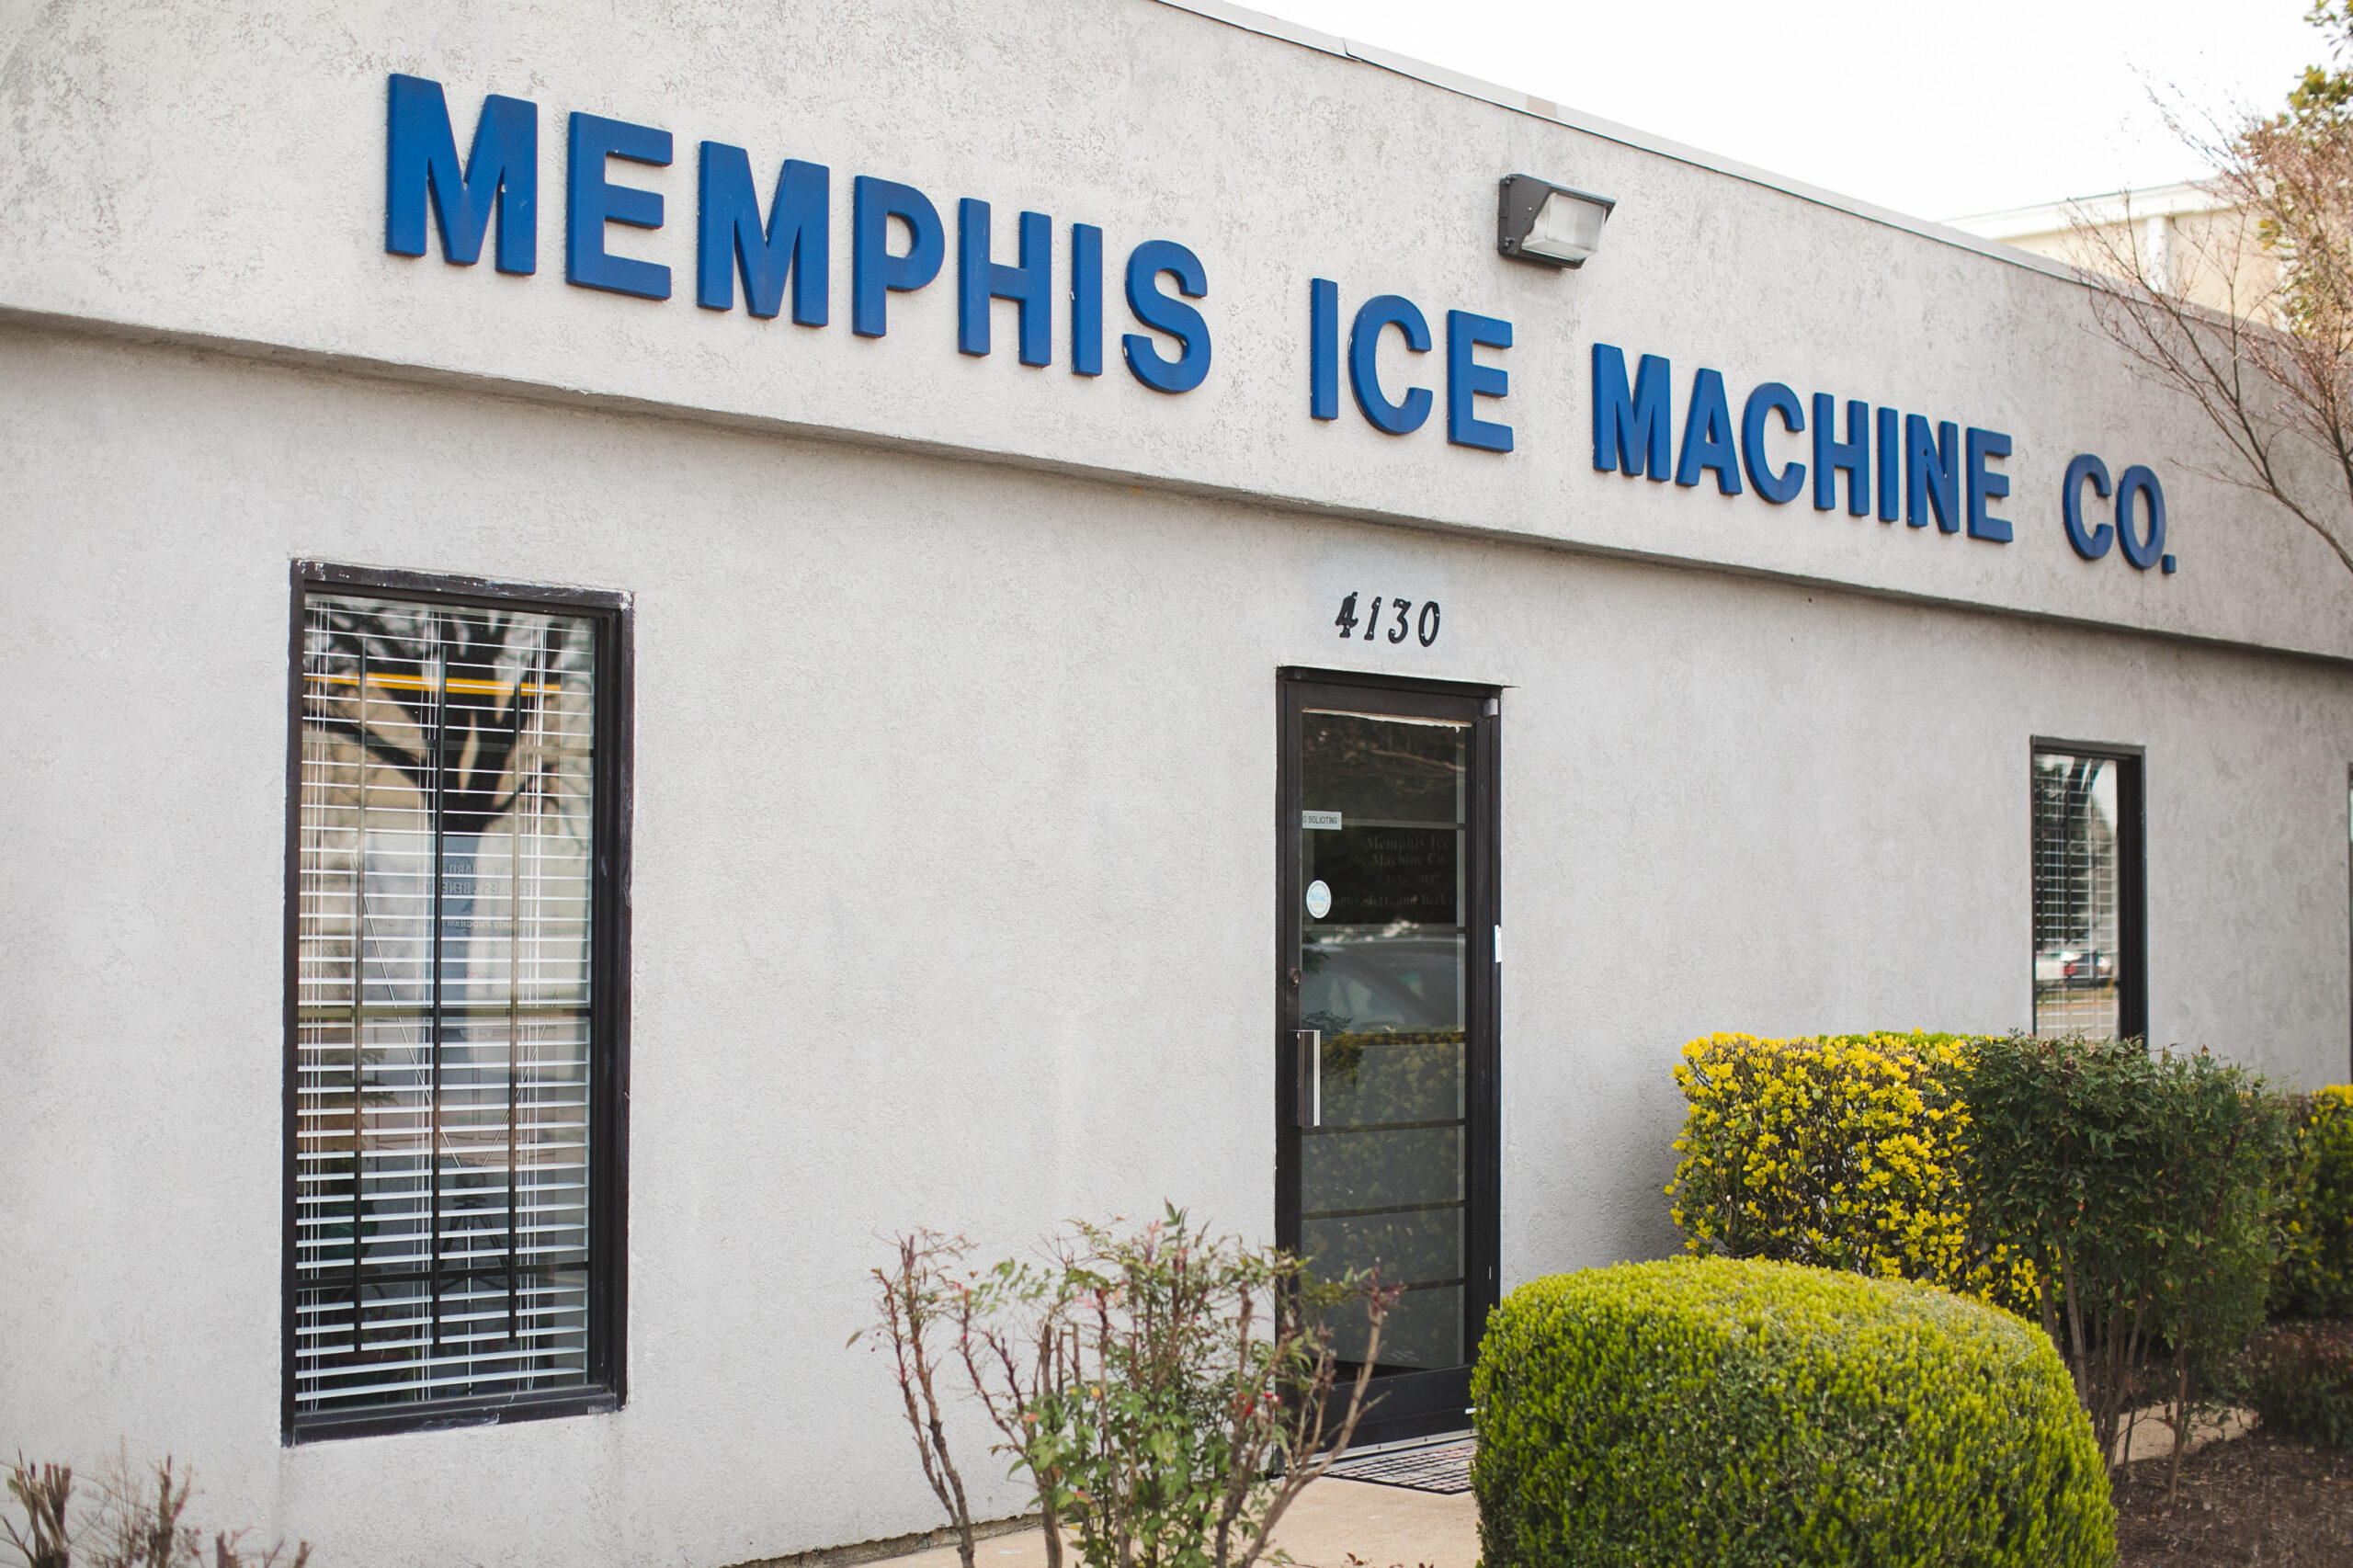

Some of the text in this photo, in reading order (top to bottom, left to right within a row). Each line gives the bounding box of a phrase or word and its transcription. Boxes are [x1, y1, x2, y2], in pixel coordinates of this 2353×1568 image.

[385, 72, 2177, 574] MEMPHIS ICE MACHINE CO.
[1336, 591, 1440, 648] 4130
[1308, 815, 1338, 824] SOLICITING
[1366, 835, 1427, 852] Memphis
[1371, 853, 1422, 866] Machine
